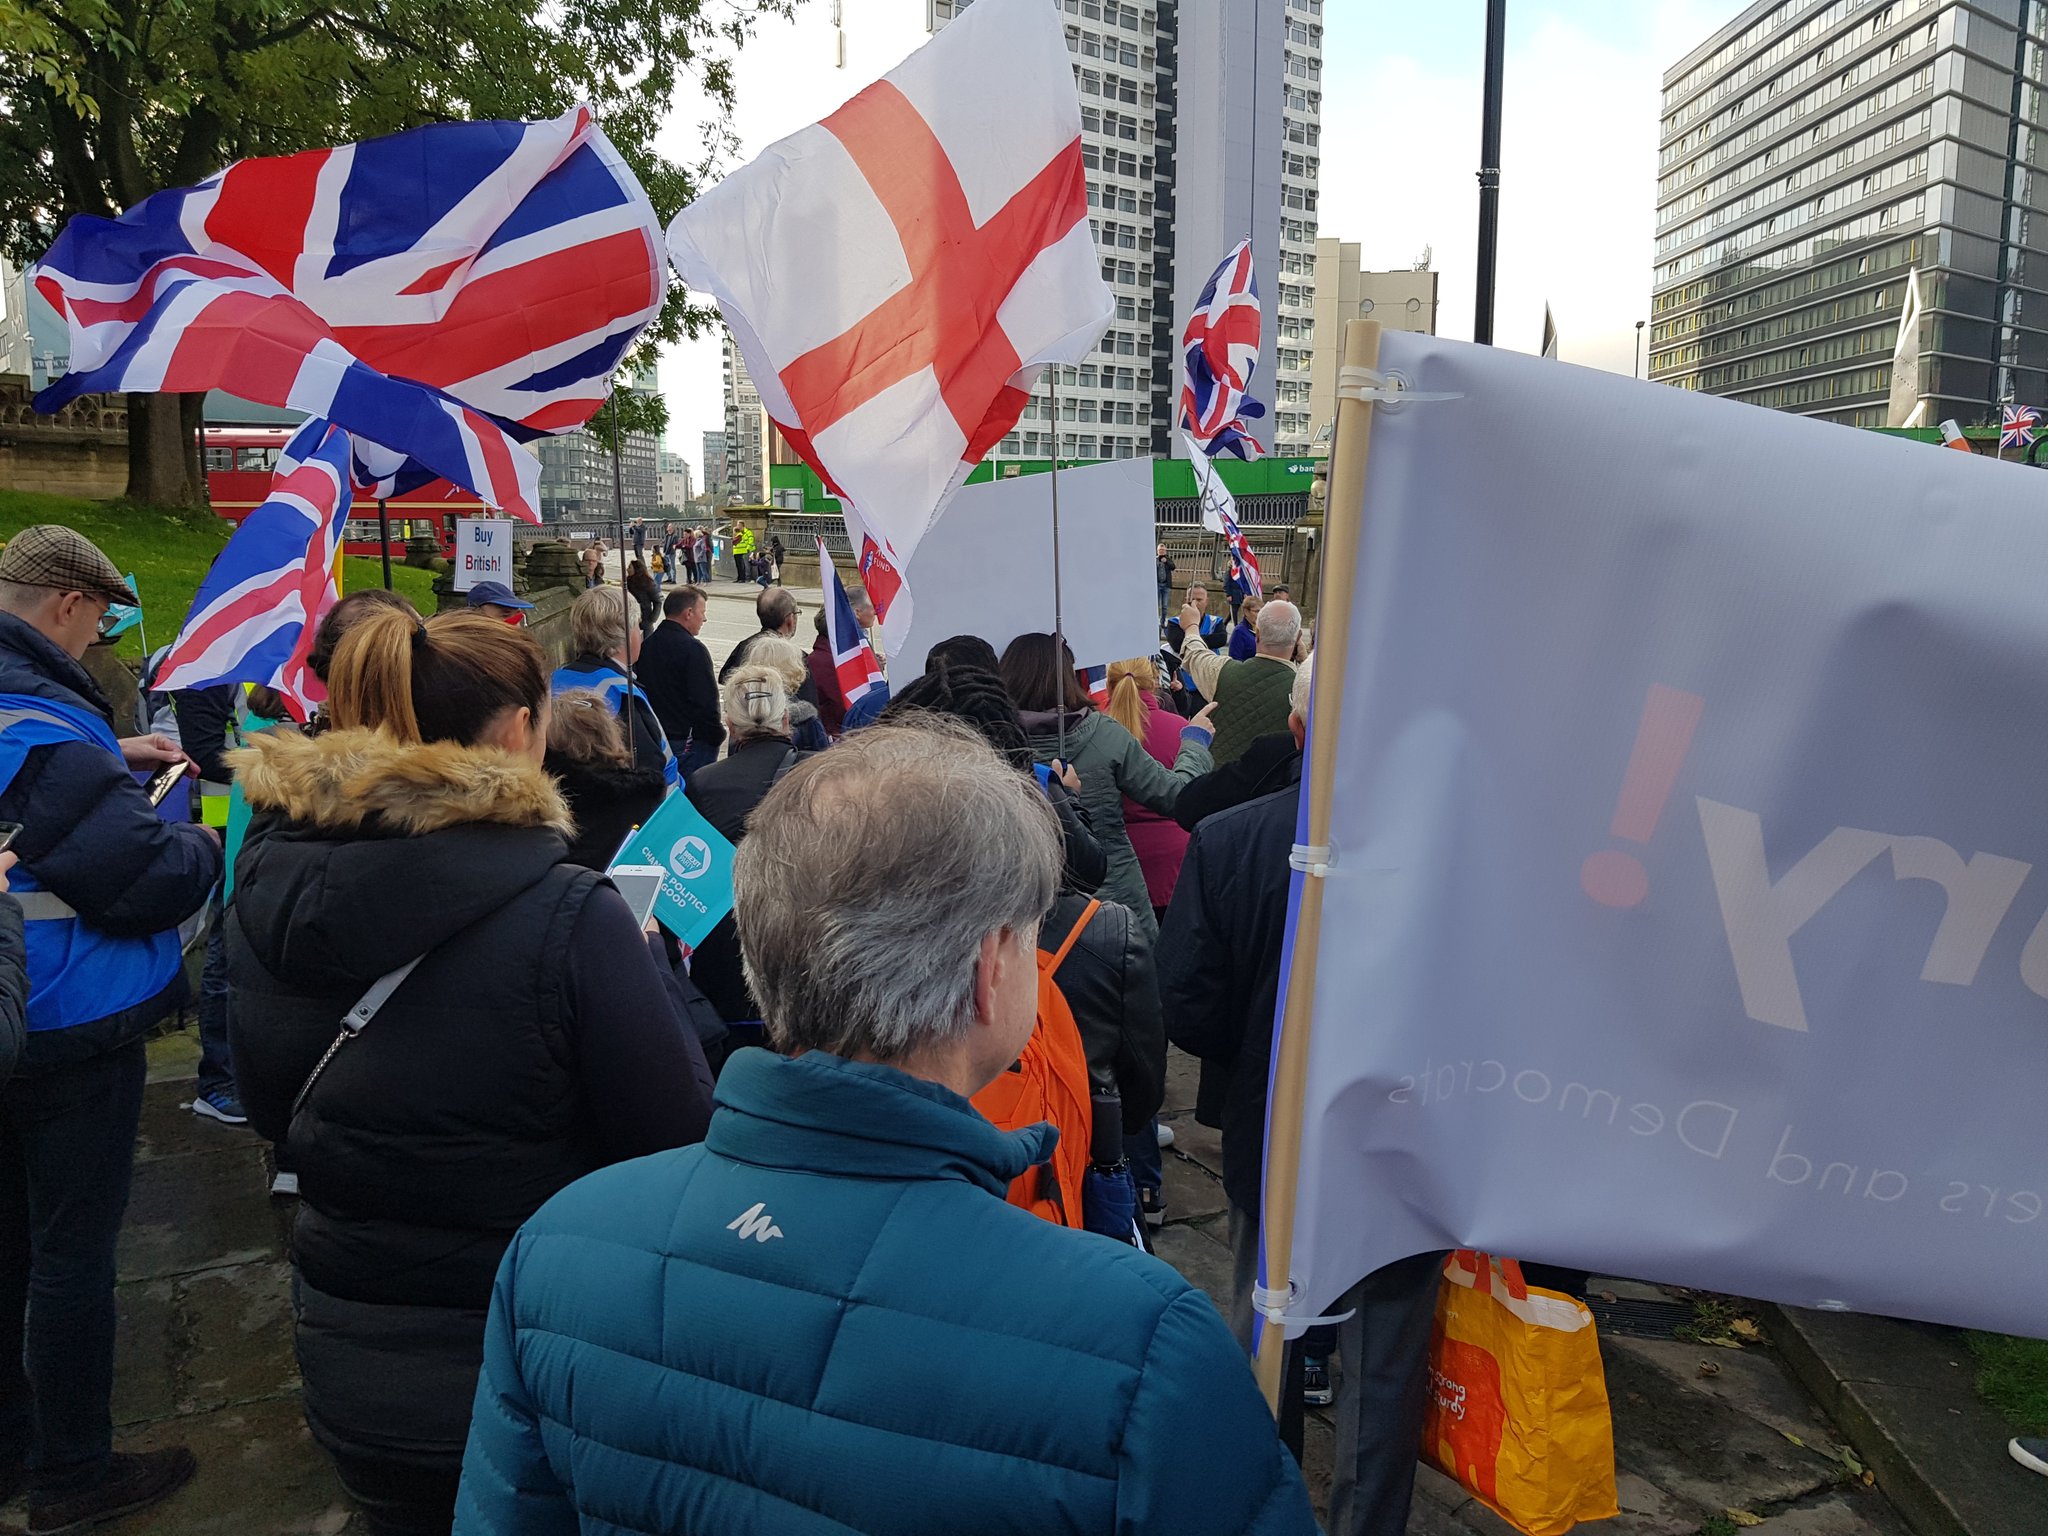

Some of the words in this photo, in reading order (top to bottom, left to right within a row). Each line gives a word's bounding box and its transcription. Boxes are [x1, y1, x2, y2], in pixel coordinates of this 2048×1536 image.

[474, 526, 493, 547] Buy
[465, 554, 501, 572] British!
[874, 557, 890, 572] FUND
[642, 847, 670, 879] CHANE
[669, 878, 707, 914] POLITICS
[661, 883, 687, 908] GOOD
